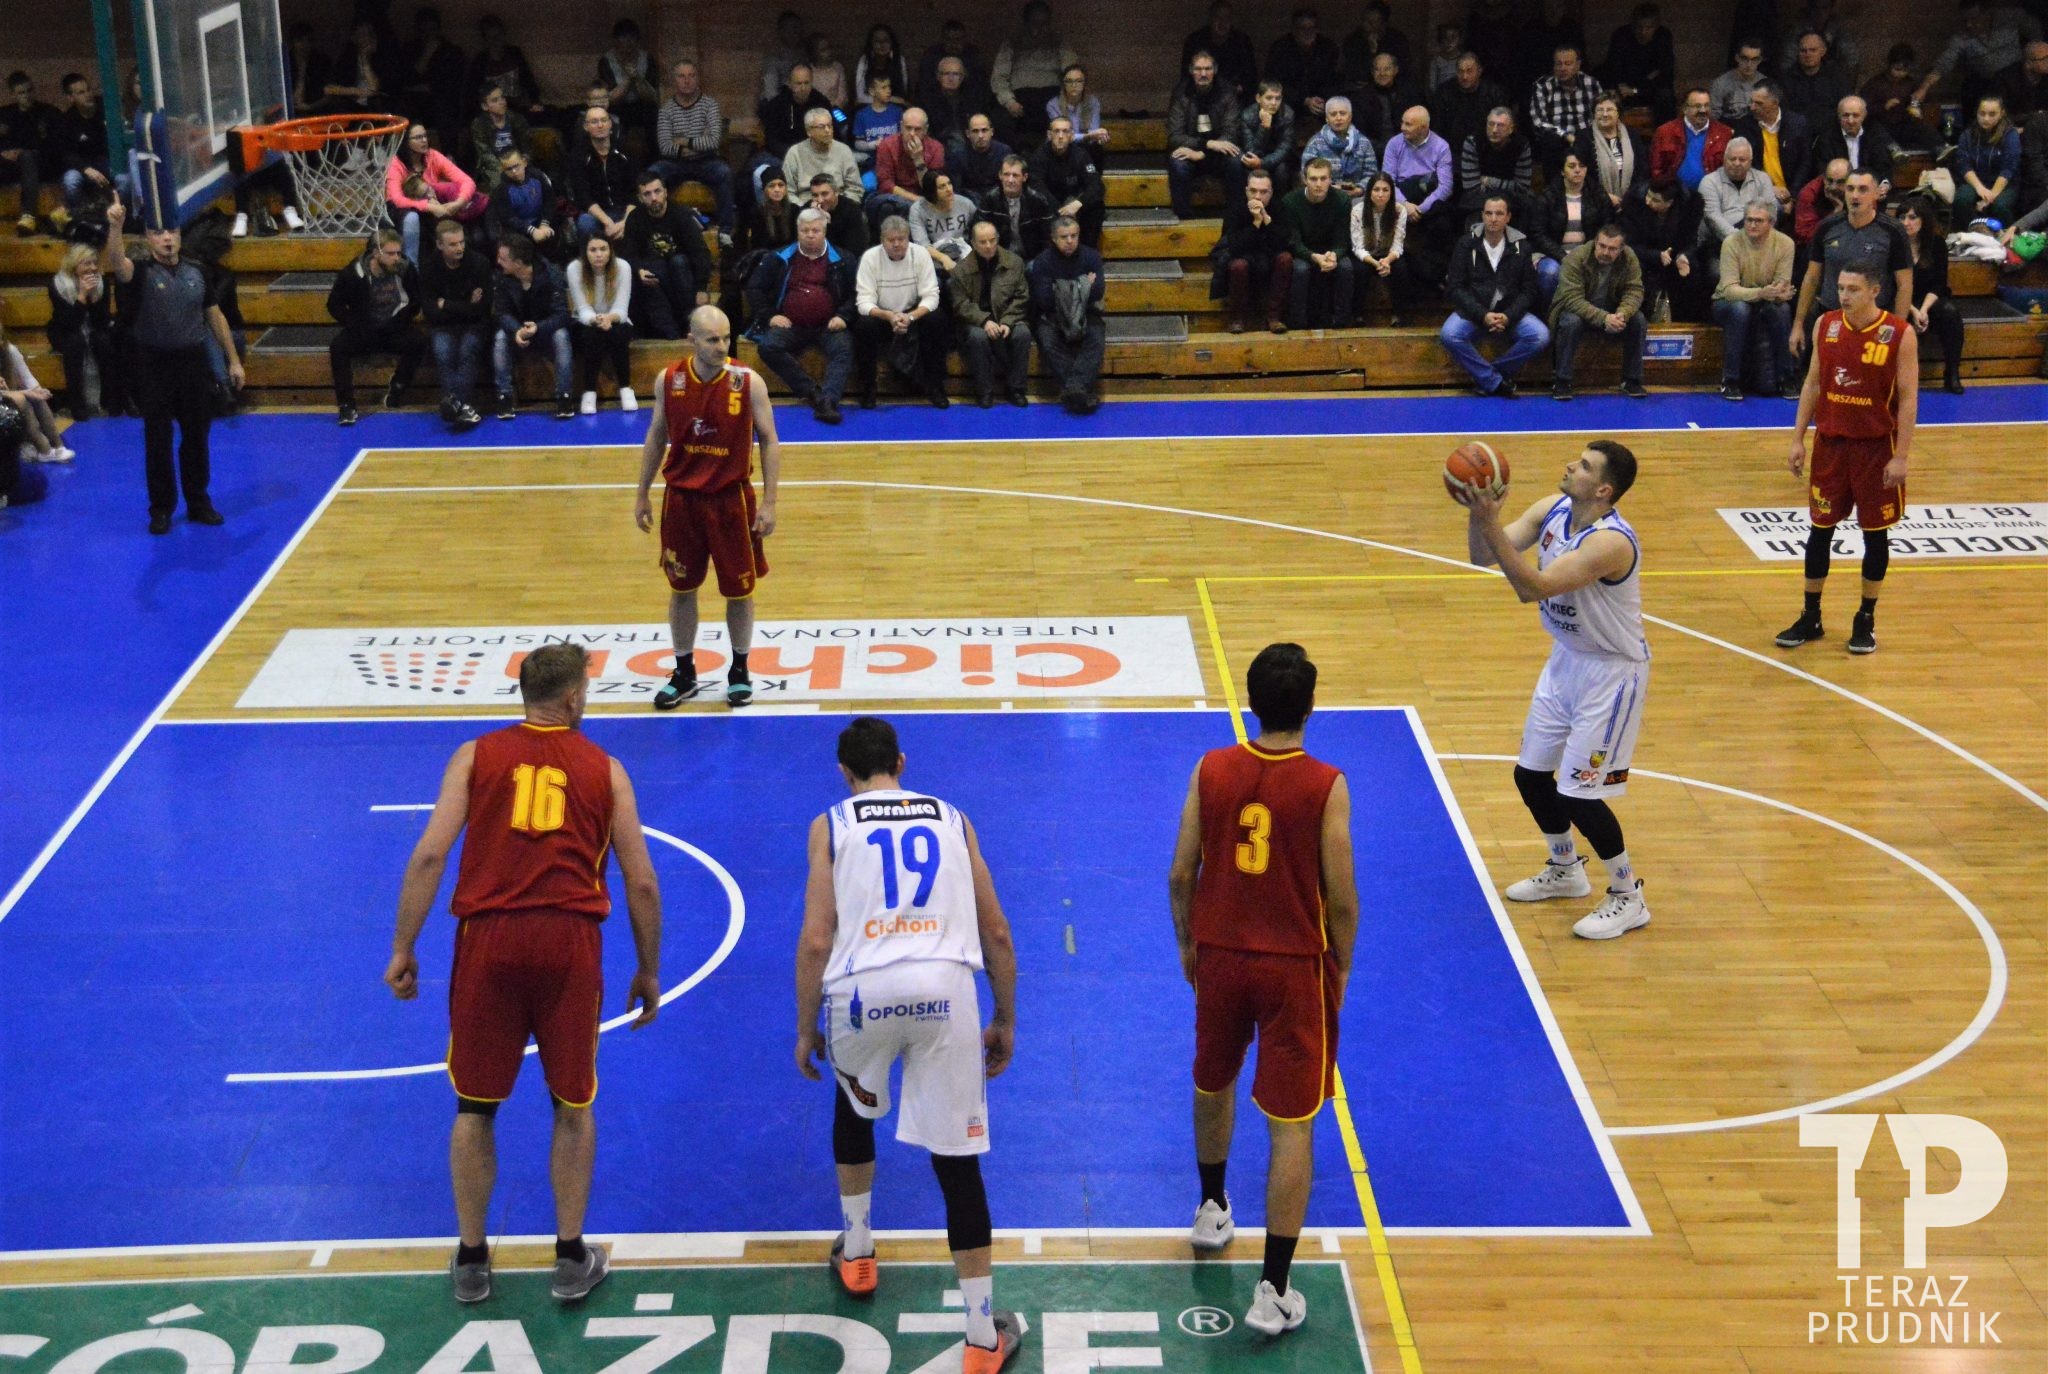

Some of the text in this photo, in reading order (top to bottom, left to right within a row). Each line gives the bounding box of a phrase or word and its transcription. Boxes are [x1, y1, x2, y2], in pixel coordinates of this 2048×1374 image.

[1861, 341, 1889, 366] 30
[728, 392, 742, 415] 5
[1740, 511, 1804, 524] 200
[1765, 538, 1854, 556] 2h
[703, 625, 1115, 641] INTERNATIONAE
[511, 763, 567, 831] 16
[1235, 803, 1271, 874] 3
[866, 825, 941, 910] 19
[867, 1000, 950, 1021] OPOLSKIE
